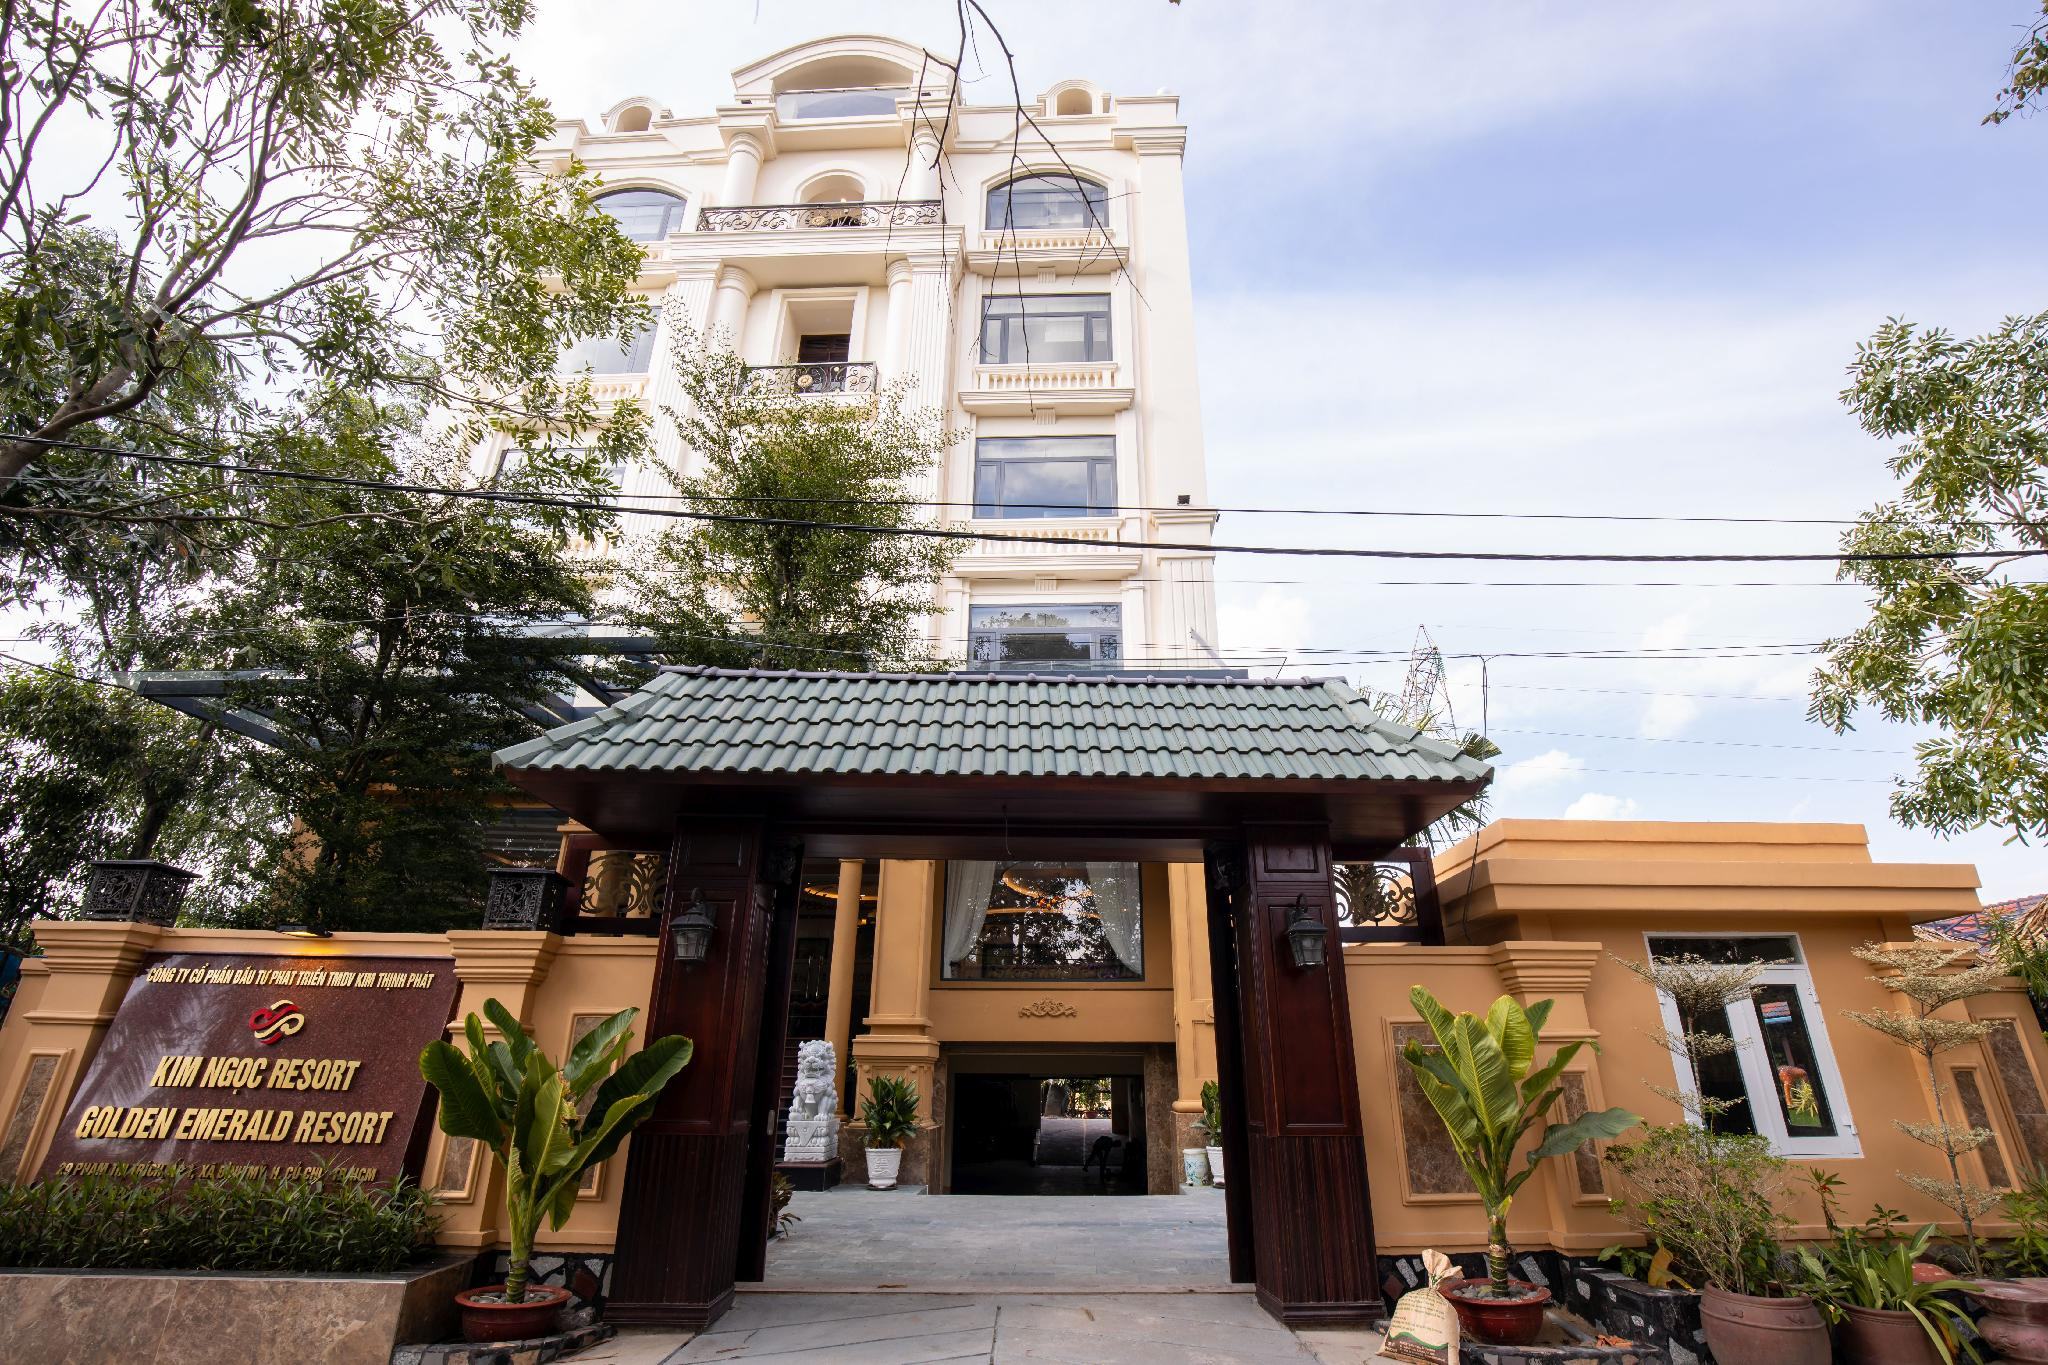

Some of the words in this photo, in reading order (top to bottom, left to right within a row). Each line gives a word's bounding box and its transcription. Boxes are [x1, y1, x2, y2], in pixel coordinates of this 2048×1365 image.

[147, 965, 176, 983] CÔNG
[175, 968, 191, 983] TY
[270, 969, 298, 986] PHÁT
[326, 972, 356, 987] TMDV
[354, 973, 376, 988] KIM
[376, 973, 408, 991] THỊNH
[406, 971, 435, 989] PHÁT
[152, 1056, 203, 1088] KIM
[200, 1056, 267, 1094] NGỌC
[267, 1059, 361, 1091] RESORT
[76, 1105, 178, 1139] GOLDEN
[174, 1107, 294, 1142] EMERALD
[293, 1111, 394, 1143] RESORT
